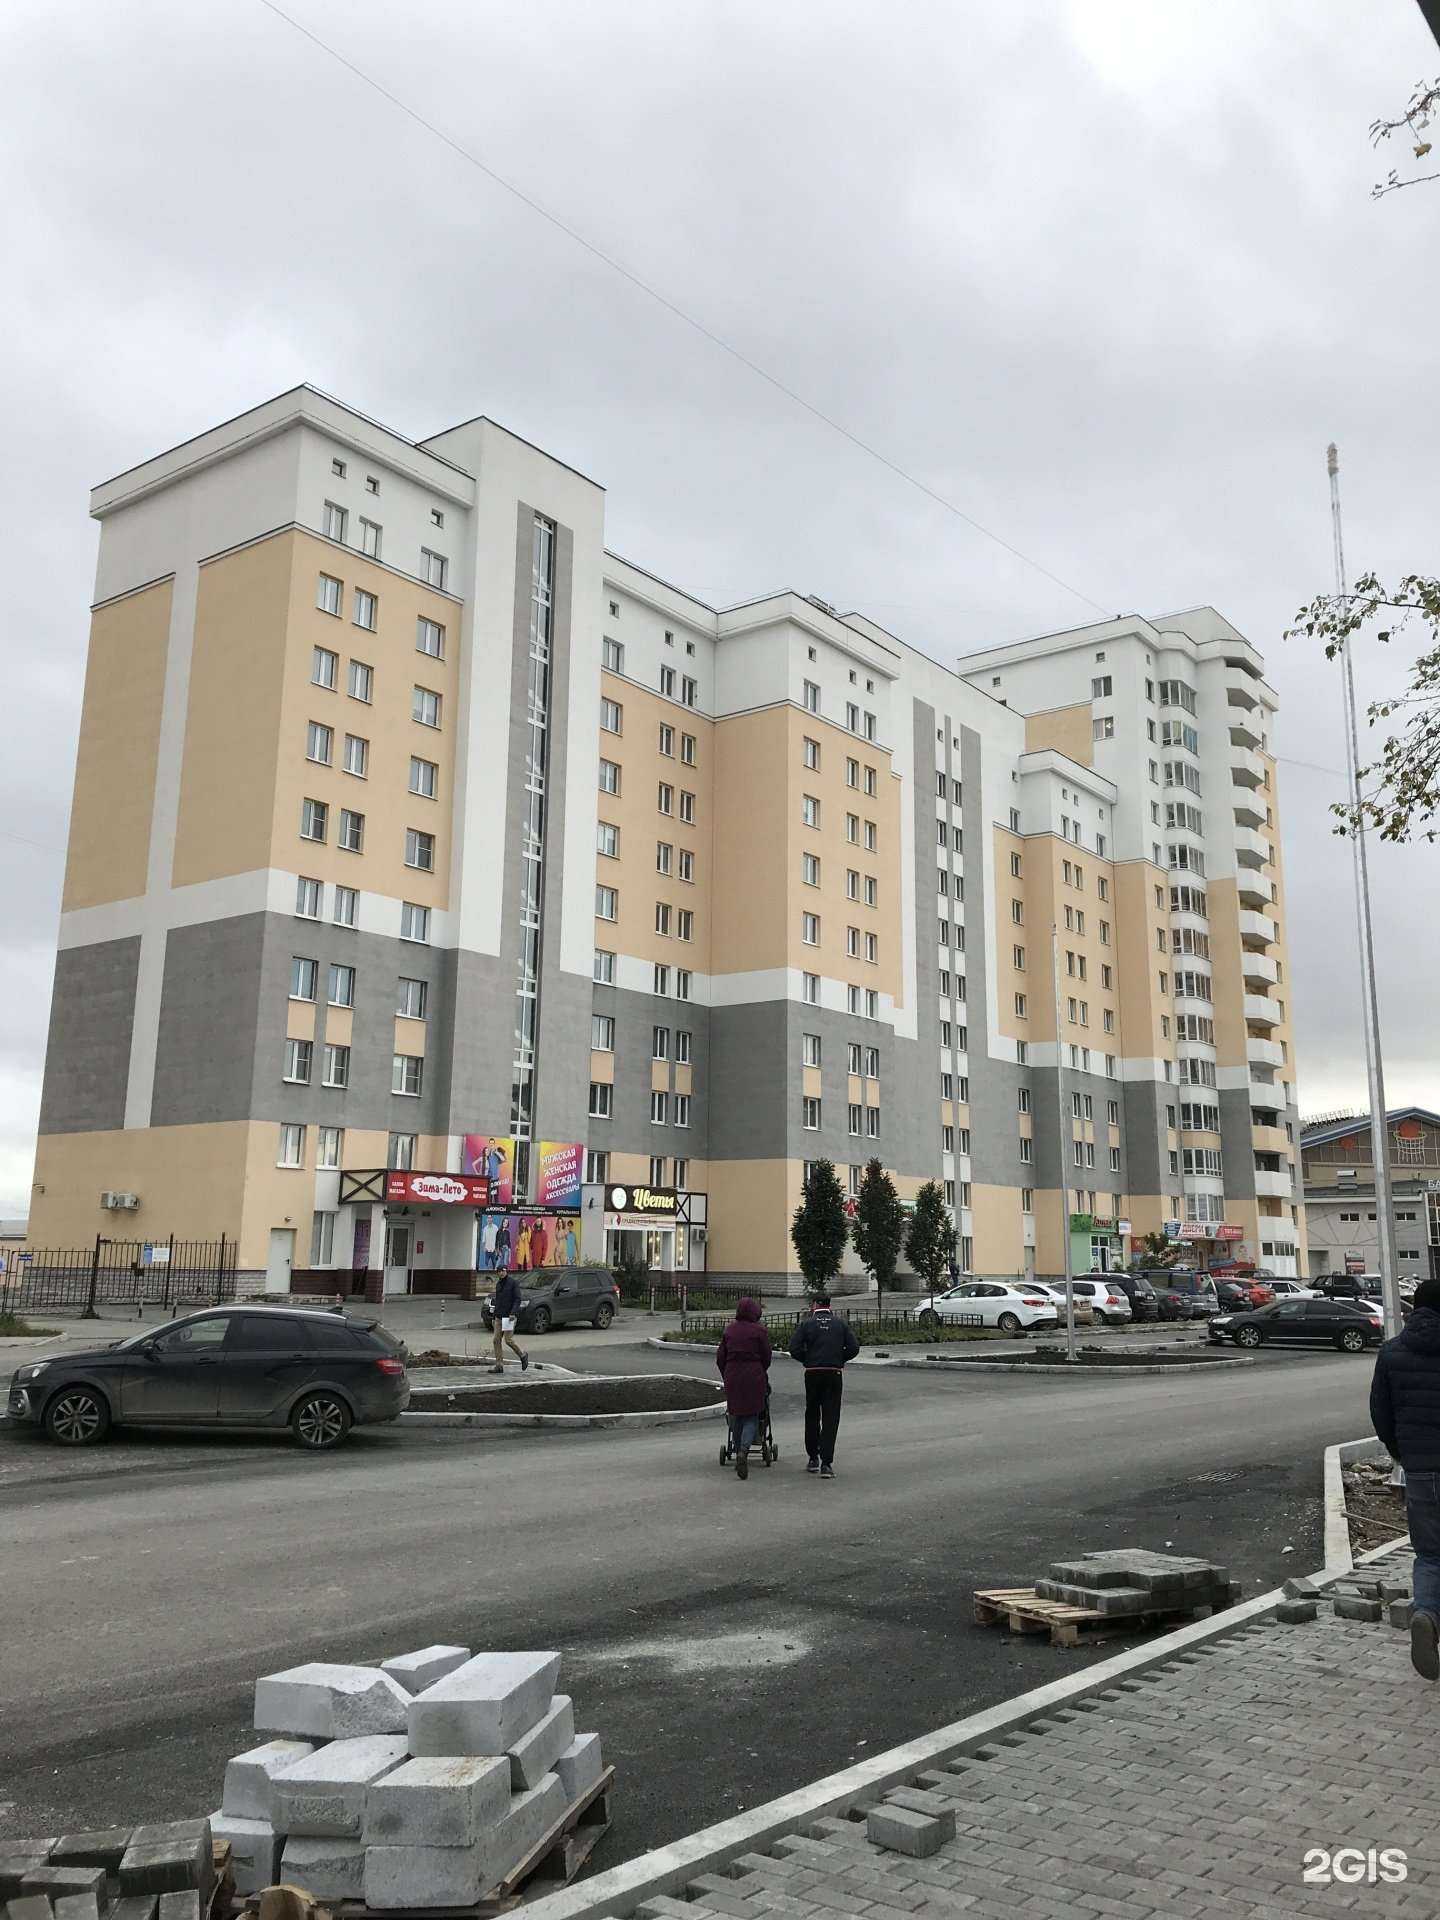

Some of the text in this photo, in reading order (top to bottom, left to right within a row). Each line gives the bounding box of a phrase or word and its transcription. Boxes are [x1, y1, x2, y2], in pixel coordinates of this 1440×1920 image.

[544, 1160, 577, 1177] ЖЕНСКАЯ
[418, 1181, 462, 1195] Зима-Лето
[546, 1173, 577, 1189] ОДЕЖДА
[633, 1188, 675, 1210] Цветы
